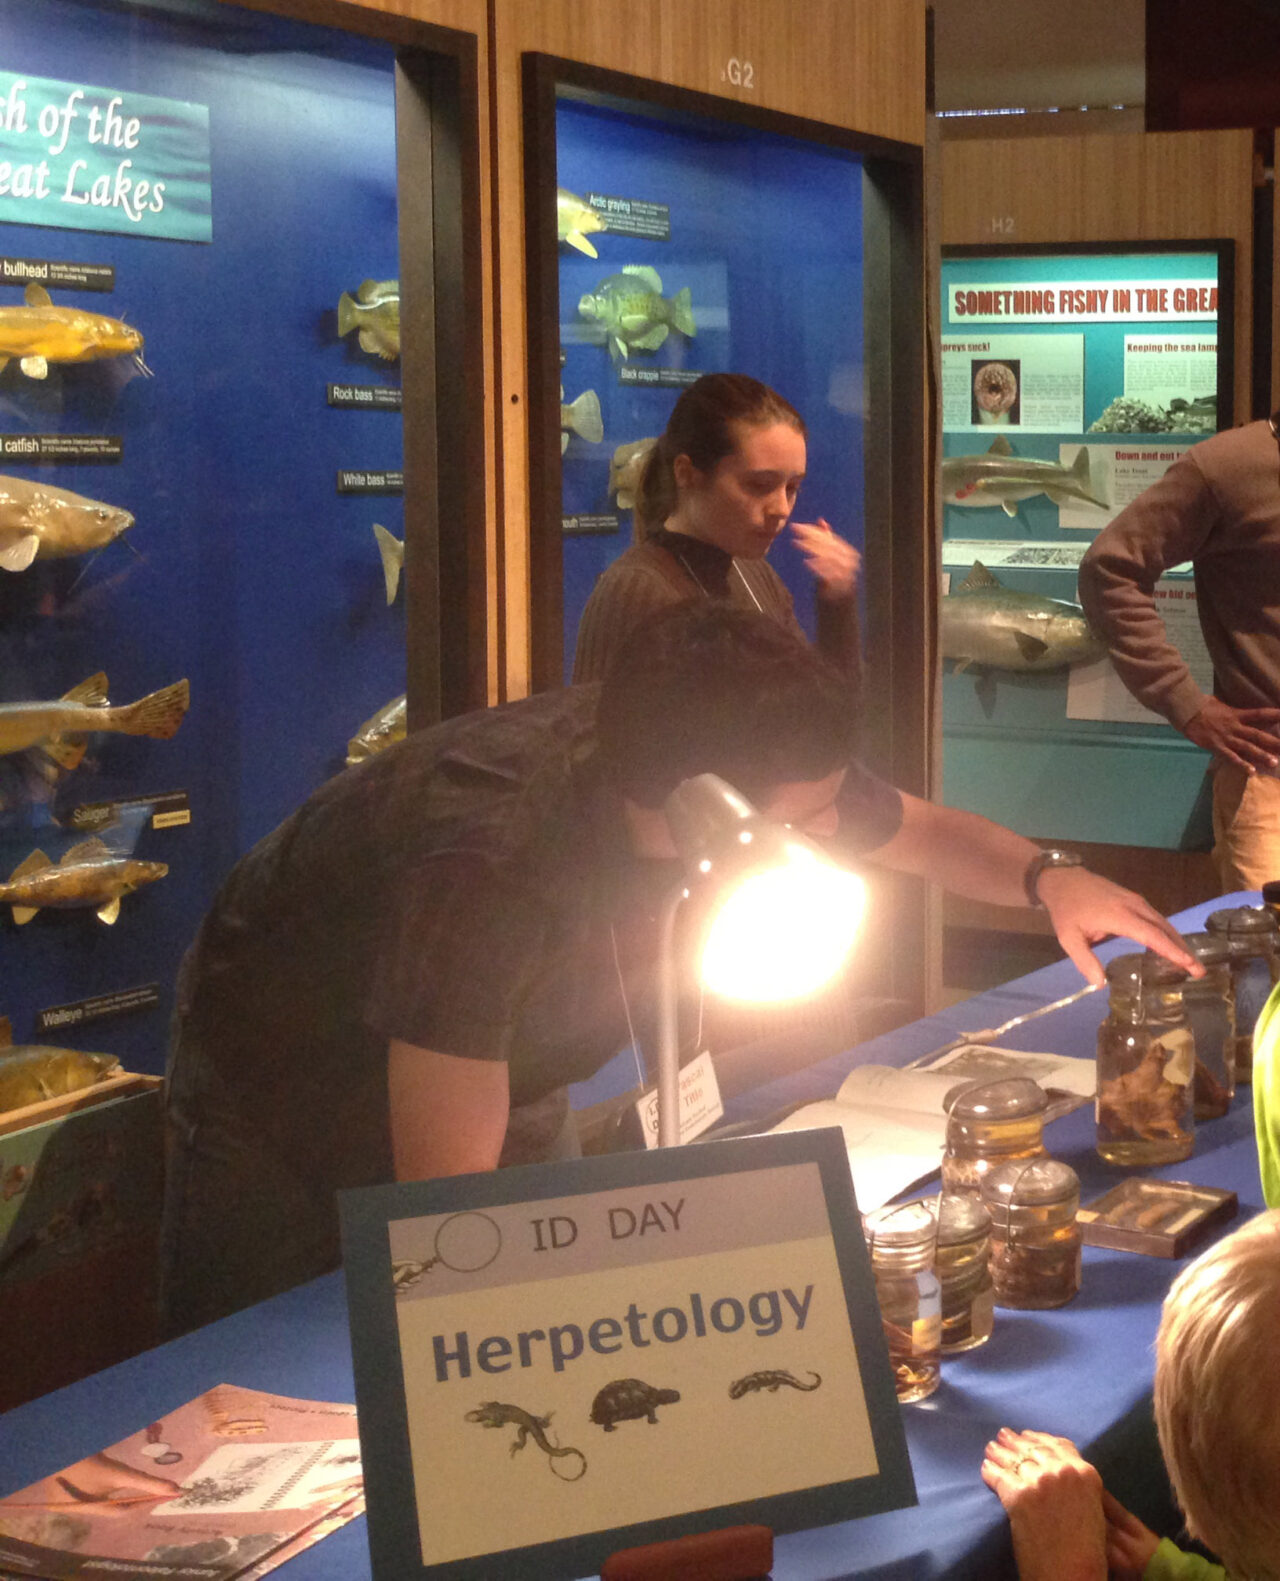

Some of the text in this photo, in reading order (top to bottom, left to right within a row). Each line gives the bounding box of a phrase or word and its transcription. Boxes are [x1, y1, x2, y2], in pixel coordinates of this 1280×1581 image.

[727, 57, 754, 89] G2
[38, 90, 84, 155] of
[88, 97, 140, 149] the
[61, 159, 166, 222] Lakes
[991, 216, 1015, 233] H2
[4, 260, 48, 279] bullhead
[955, 289, 1055, 316] SOMETHING
[1059, 289, 1109, 314] FISHY
[1113, 288, 1131, 313] IN
[1135, 288, 1168, 313] THE
[968, 342, 990, 352] suck!
[1127, 344, 1163, 353] Keeping
[1164, 343, 1179, 352] the
[1180, 344, 1197, 352] sea
[333, 386, 354, 400] Rock
[354, 387, 373, 401] bass
[5, 437, 39, 453] catfish
[1115, 451, 1140, 460] Down
[1141, 451, 1159, 460] and
[343, 472, 366, 486] White
[367, 473, 385, 486] bass
[42, 1008, 82, 1027] Walleye
[530, 1199, 686, 1252] ID DAY
[431, 1285, 815, 1382] Herpetology
